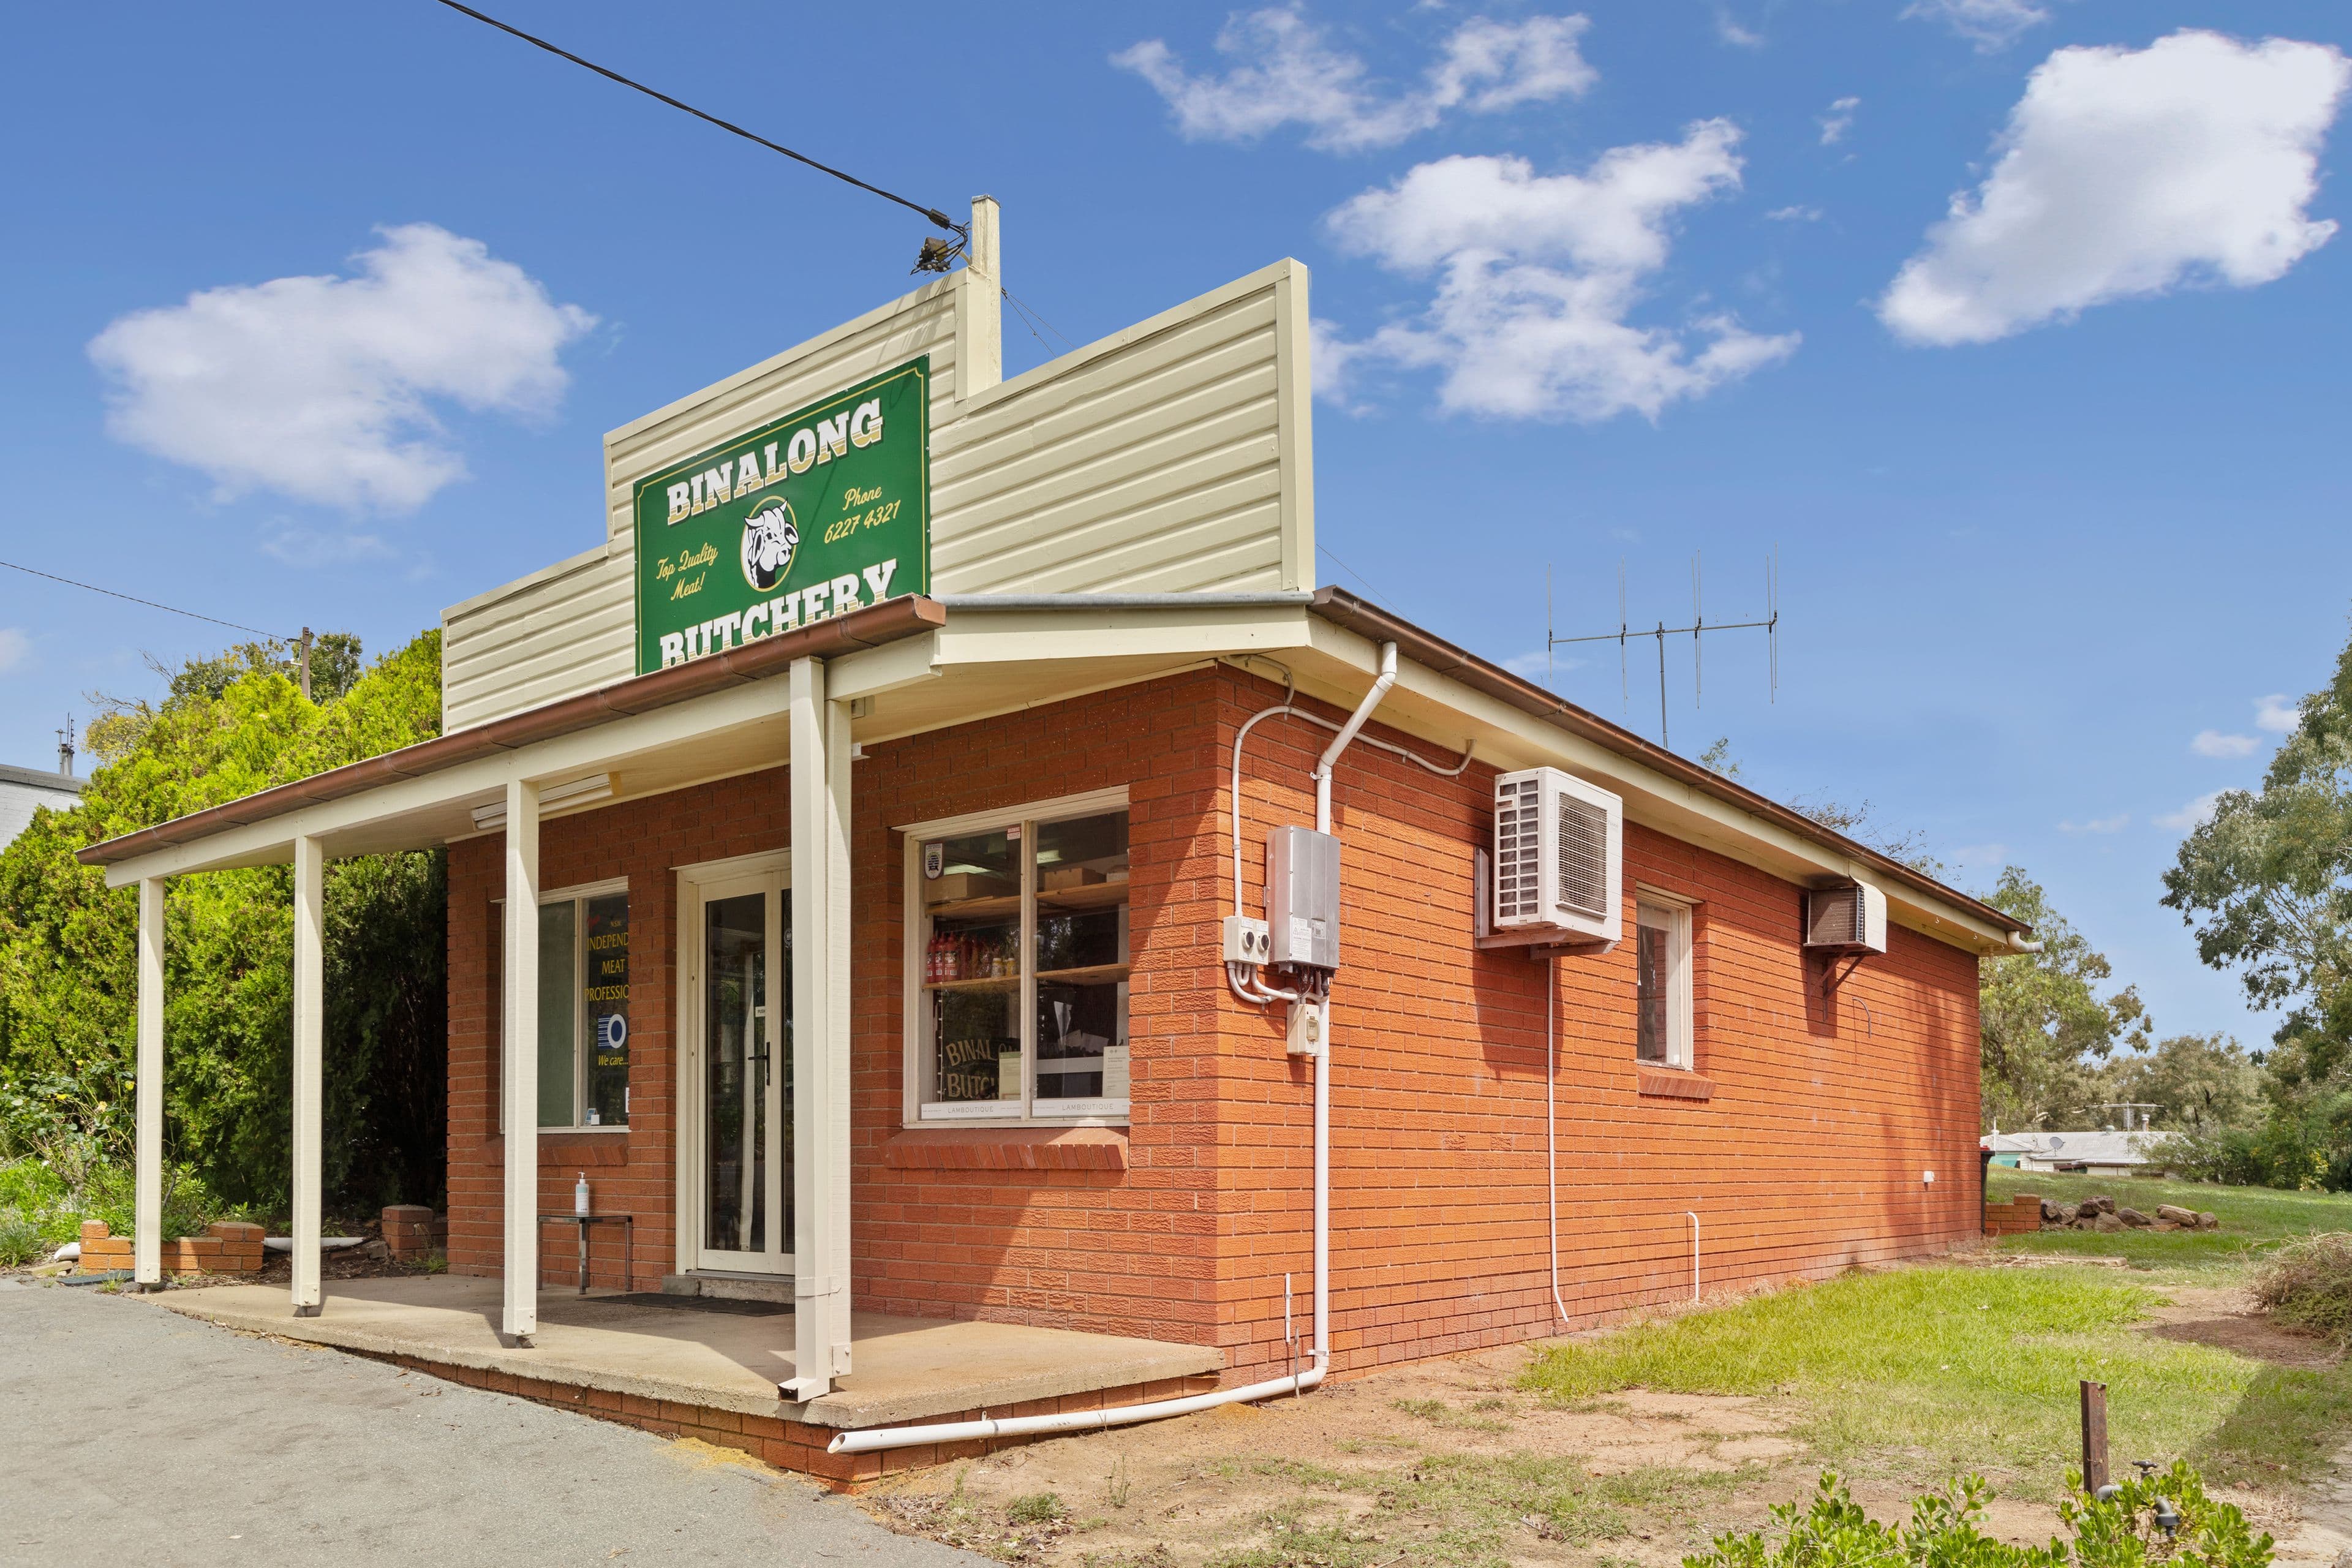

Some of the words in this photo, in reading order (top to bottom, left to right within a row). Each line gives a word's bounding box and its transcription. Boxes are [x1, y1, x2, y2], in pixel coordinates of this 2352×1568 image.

[666, 398, 883, 527] BINALONG
[843, 486, 882, 510] Phone
[824, 514, 861, 544] 6227
[864, 499, 901, 529] 4321
[656, 557, 675, 581] Top
[678, 542, 718, 571] Quality
[670, 571, 706, 601] Meat!
[660, 558, 897, 669] BUTCHERY
[601, 959, 625, 974] MEAT
[598, 1055, 608, 1066] We
[609, 1056, 628, 1066] care...
